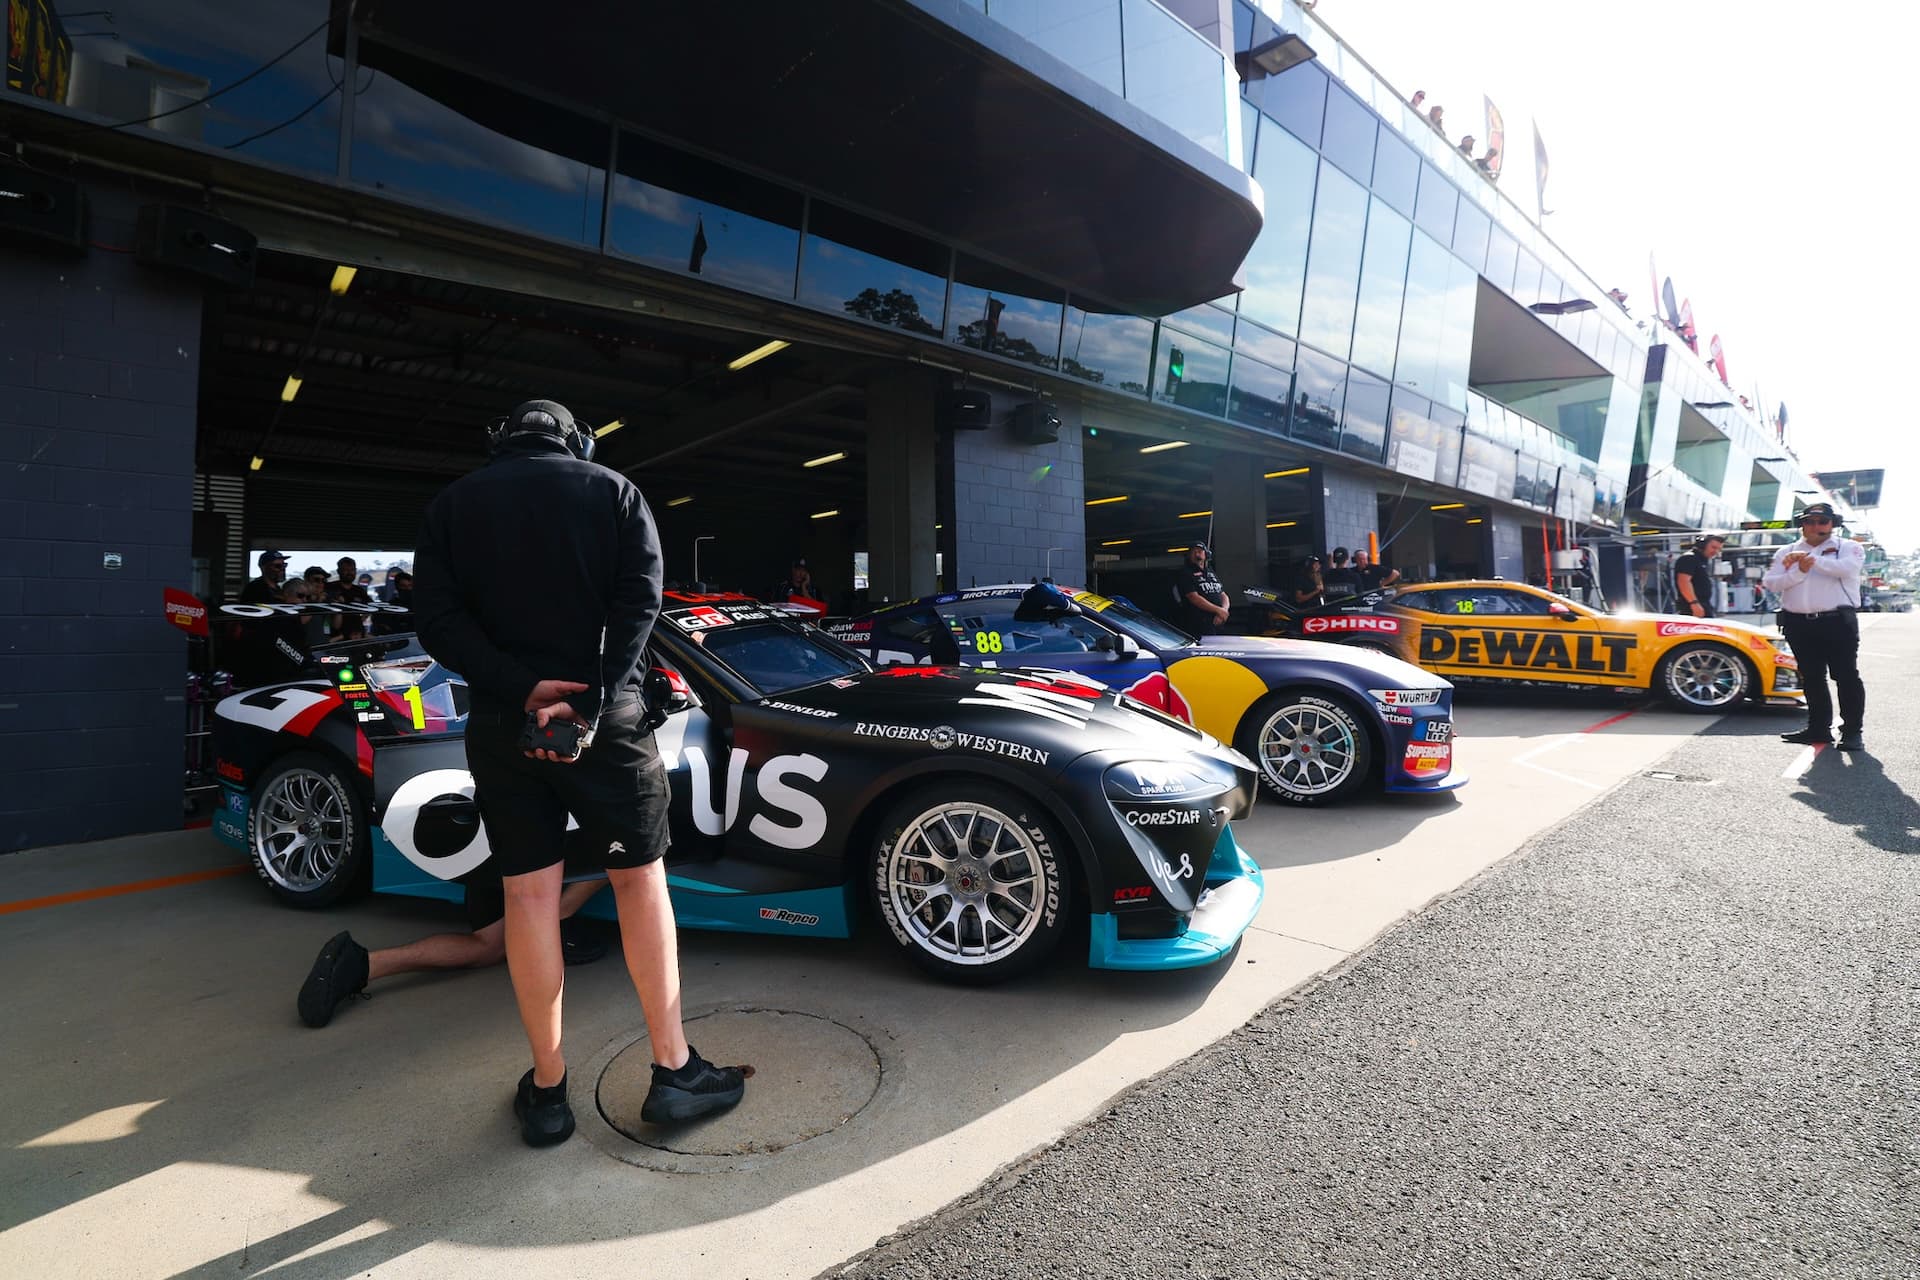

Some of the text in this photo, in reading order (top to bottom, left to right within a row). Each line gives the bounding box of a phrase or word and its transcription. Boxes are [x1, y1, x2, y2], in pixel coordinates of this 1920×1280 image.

[962, 591, 991, 600] BROC
[1456, 600, 1475, 614] 18
[677, 613, 731, 630] GR
[1330, 618, 1398, 631] HINO
[975, 631, 1003, 654] 88
[1419, 628, 1637, 673] DEWALT
[403, 686, 425, 729] 1
[770, 701, 838, 718] DUNLOP
[1299, 696, 1359, 731] SPORT MAXX
[853, 722, 930, 742] RINGERS
[956, 732, 1050, 766] WESTERN
[1425, 732, 1449, 743] LOCK
[1141, 785, 1166, 795] SPARK
[381, 747, 829, 880] OUS
[1126, 809, 1201, 826] CORESTAFF
[219, 820, 244, 840] move
[1027, 826, 1060, 929] DUNLOP
[876, 841, 912, 947] SPORT MAXX
[776, 909, 819, 926] Repco
